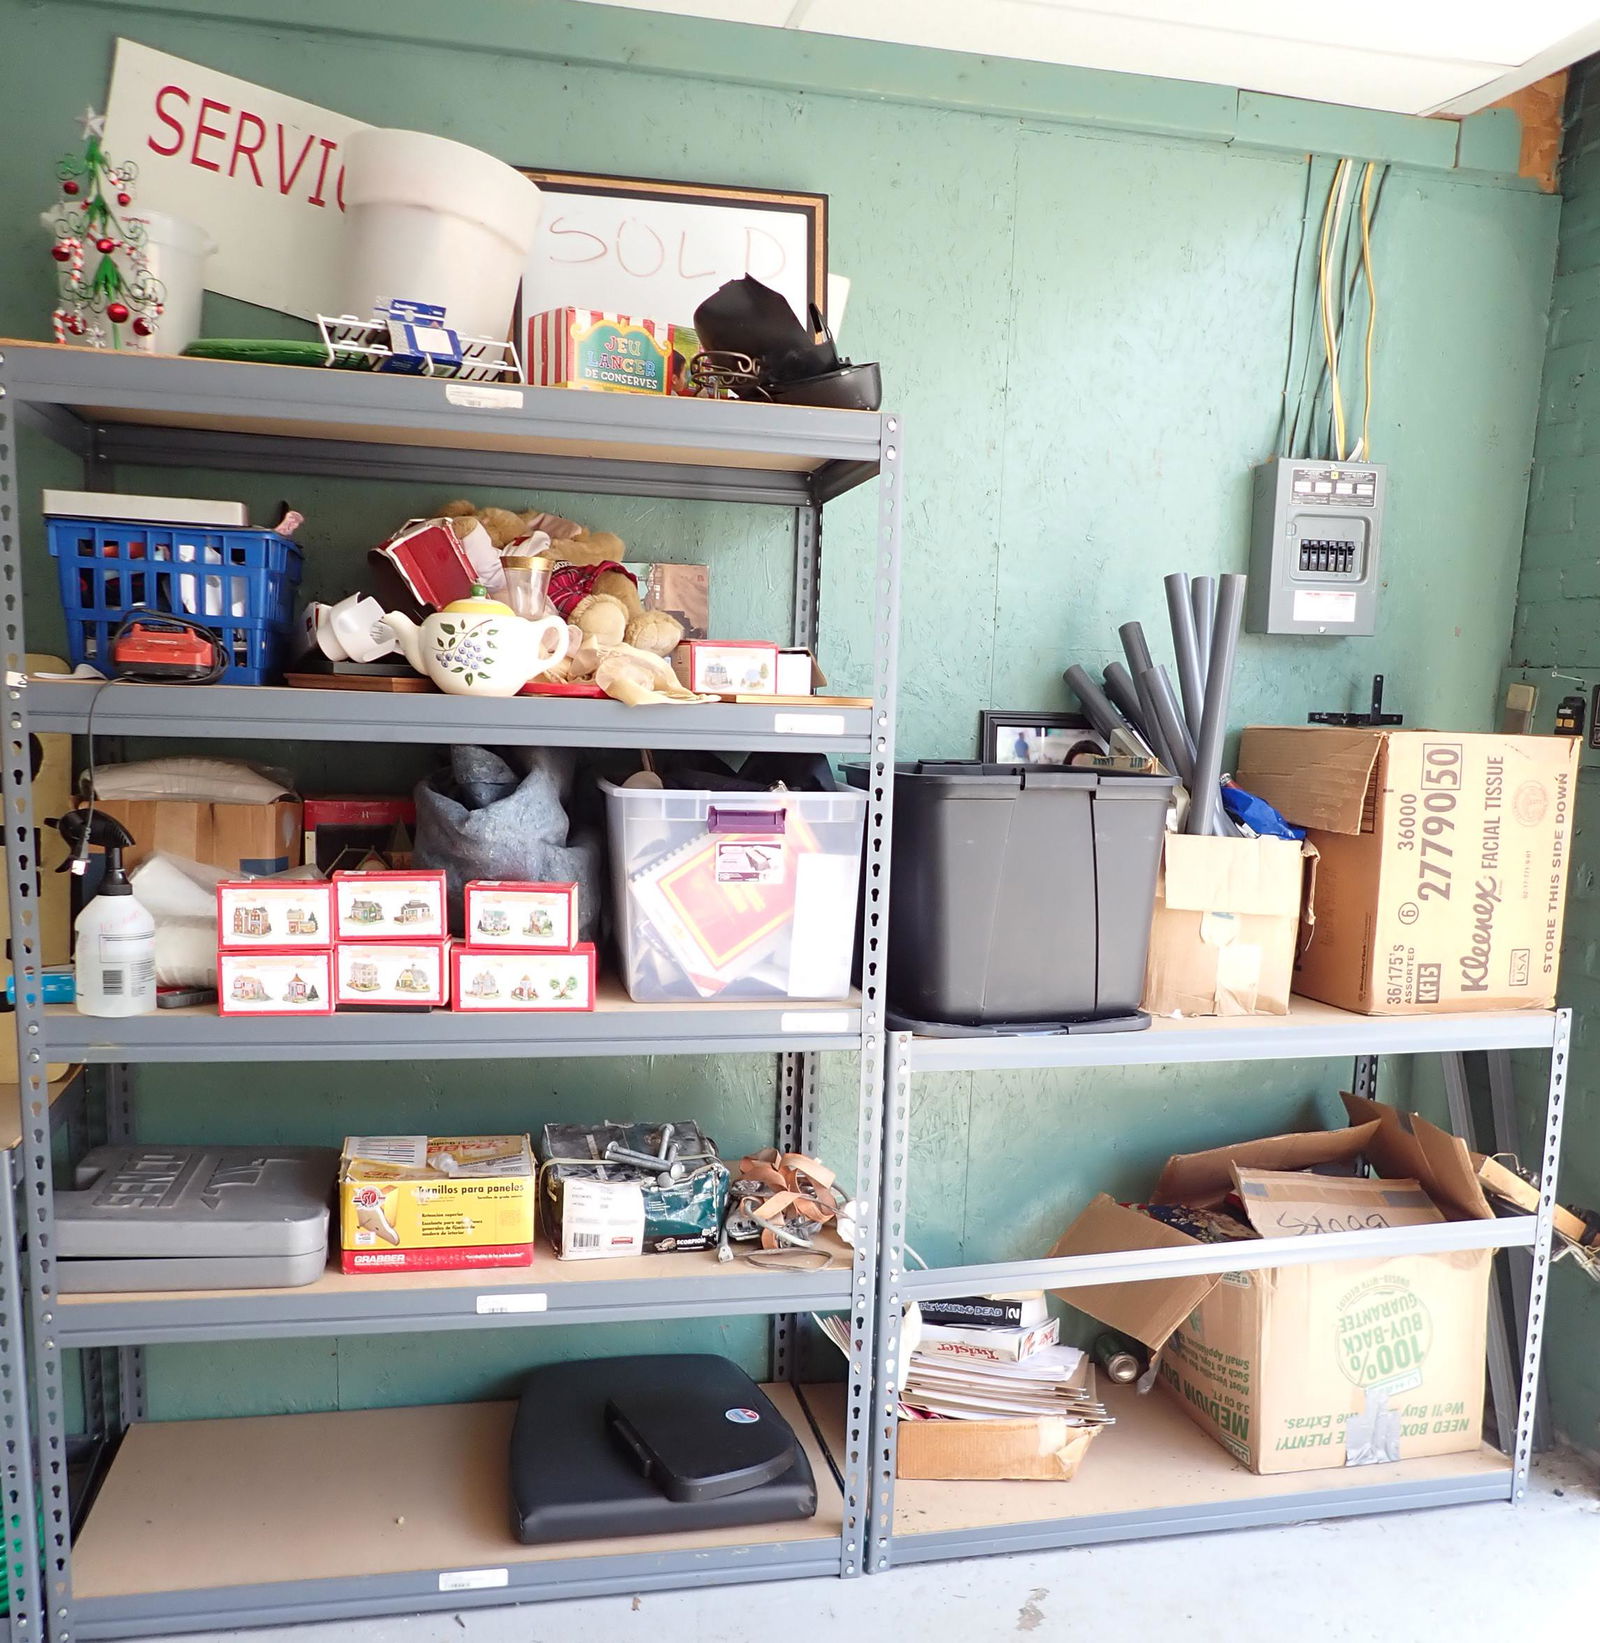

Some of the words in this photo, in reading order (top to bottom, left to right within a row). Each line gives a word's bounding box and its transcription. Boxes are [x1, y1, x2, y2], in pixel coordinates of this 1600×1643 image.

[549, 215, 787, 282] SOLD
[604, 336, 641, 356] JEU
[586, 350, 656, 377] LANCER
[585, 368, 598, 378] DE
[600, 371, 658, 390] CONSERVES
[1484, 755, 1504, 811] TISSUE
[1555, 773, 1568, 824] DOWN
[1397, 794, 1417, 851] 36000
[1481, 816, 1501, 869] FACIAL
[1552, 831, 1563, 868] SIDE
[1548, 874, 1560, 913] THIS
[1459, 876, 1502, 992] Kleenex
[1543, 919, 1556, 973] STORE
[1405, 947, 1415, 1004] ASSORTED
[1516, 953, 1528, 983] USA
[1417, 966, 1439, 1001] KF15
[461, 1185, 484, 1195] para
[487, 1182, 524, 1194] paneles
[1275, 1212, 1391, 1236] BOOKS
[676, 1236, 706, 1245] SCORPION
[354, 1254, 406, 1264] GRABBER
[934, 1303, 974, 1314] WALKING
[974, 1306, 1002, 1317] DEAD
[1008, 1308, 1020, 1319] 2
[1338, 1292, 1418, 1333] GUARANTEE
[1342, 1312, 1422, 1356] BUY-BACK
[937, 1343, 999, 1361] Twister
[1226, 1355, 1250, 1370] Small
[1349, 1335, 1424, 1389] 100%
[1217, 1364, 1226, 1375] As
[1228, 1367, 1249, 1382] Such
[1228, 1380, 1249, 1396] Most
[1183, 1380, 1249, 1440] MEDIUM
[1224, 1395, 1234, 1408] CU
[1403, 1402, 1429, 1418] Buy
[1432, 1401, 1464, 1418] We'll
[1284, 1414, 1332, 1431] Extras.
[1433, 1418, 1470, 1434] NEED
[1275, 1433, 1333, 1451] PLENTY!
